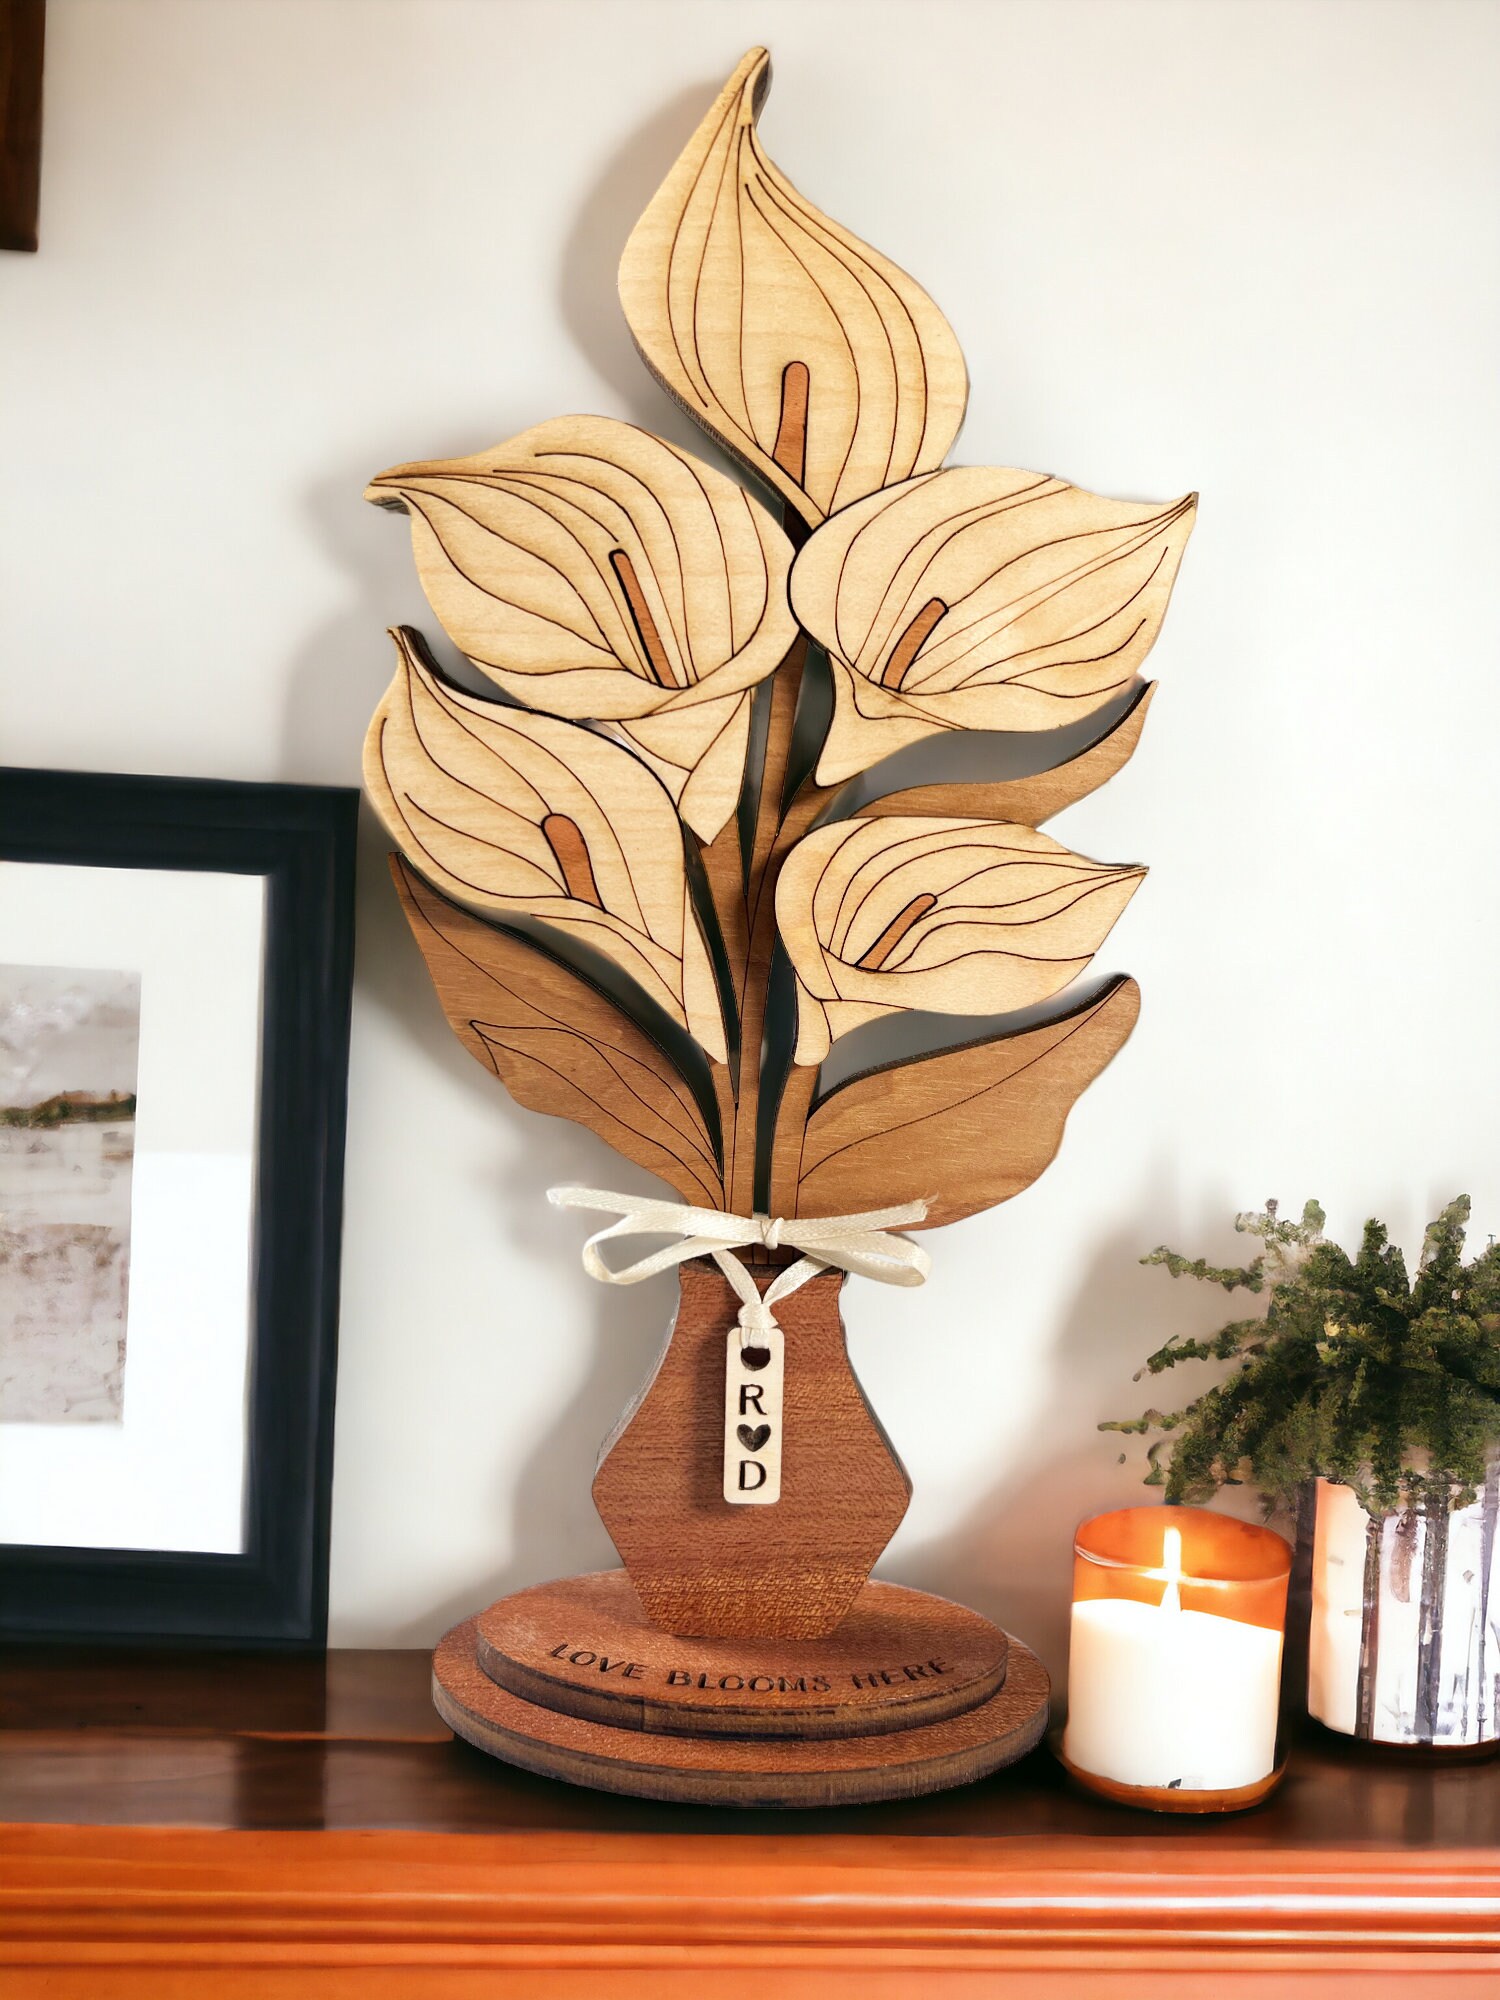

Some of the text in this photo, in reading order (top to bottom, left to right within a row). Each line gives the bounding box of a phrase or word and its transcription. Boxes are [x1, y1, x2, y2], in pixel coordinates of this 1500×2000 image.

[738, 1384, 768, 1491] R D
[550, 1643, 956, 1693] LOVE BLOOMS HERE
